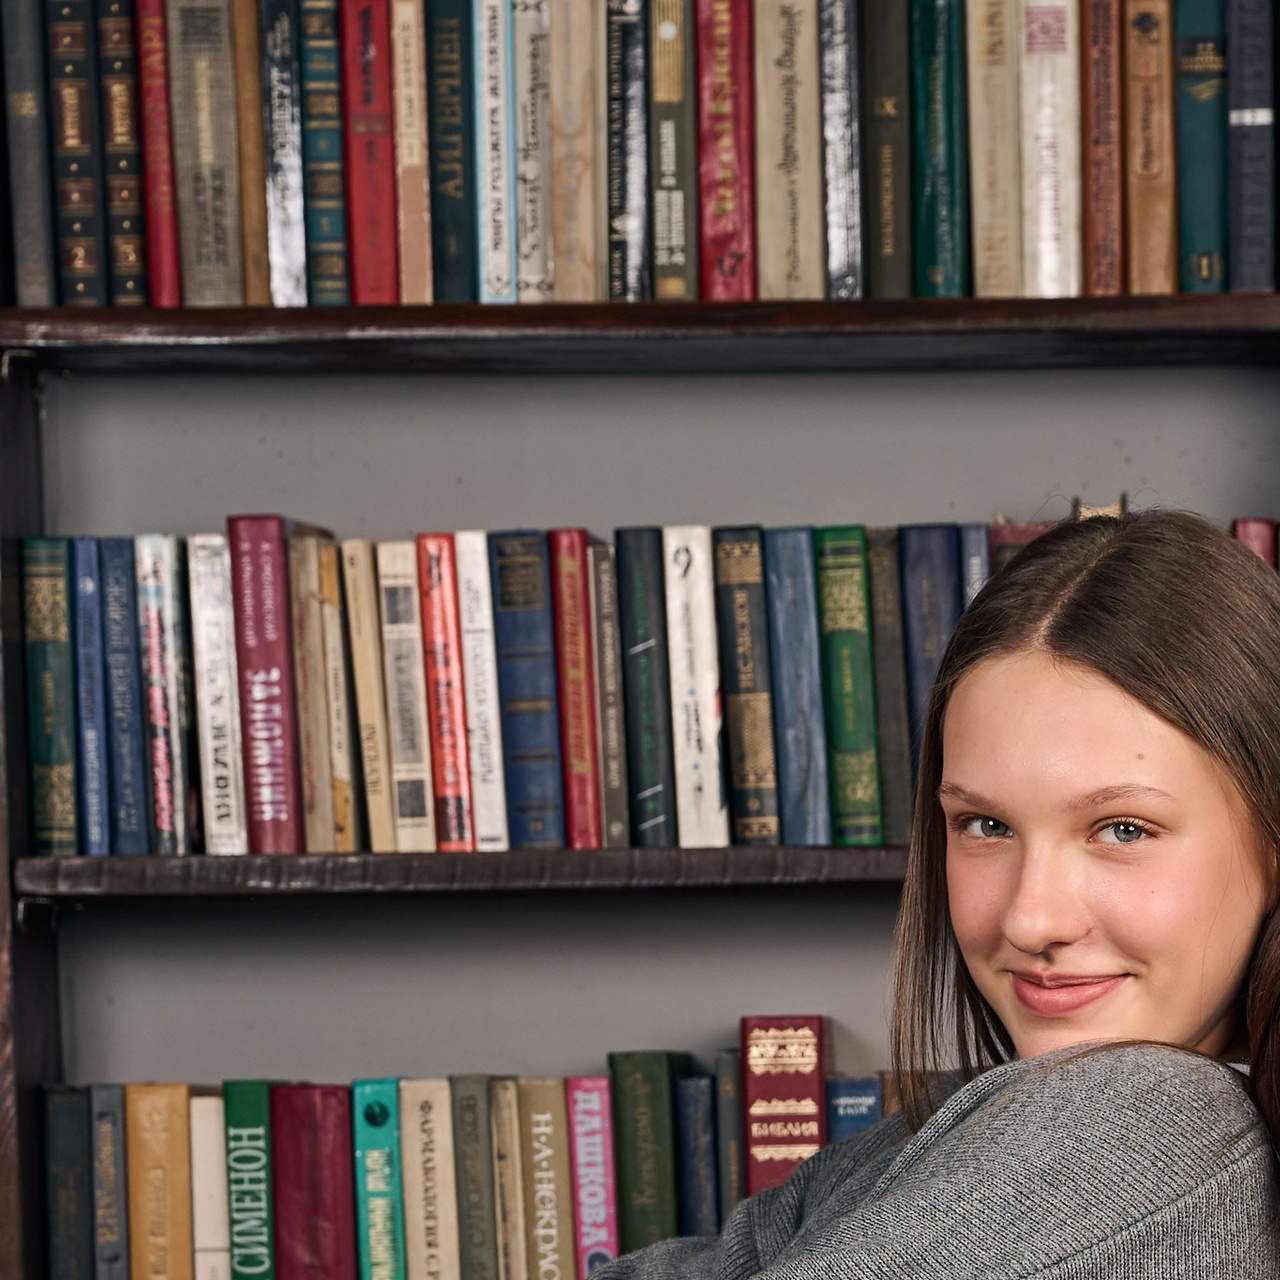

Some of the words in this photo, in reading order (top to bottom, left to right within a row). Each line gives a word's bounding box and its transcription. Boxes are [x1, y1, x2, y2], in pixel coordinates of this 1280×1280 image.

[227, 1126, 271, 1275] СИМЕНОН
[420, 1099, 441, 1249] ФАРМАКОЛОГИЯ
[576, 1090, 609, 1247] ДАШКОВА
[751, 1121, 820, 1141] БИБЛИЯ
[426, 1253, 439, 1267] С
